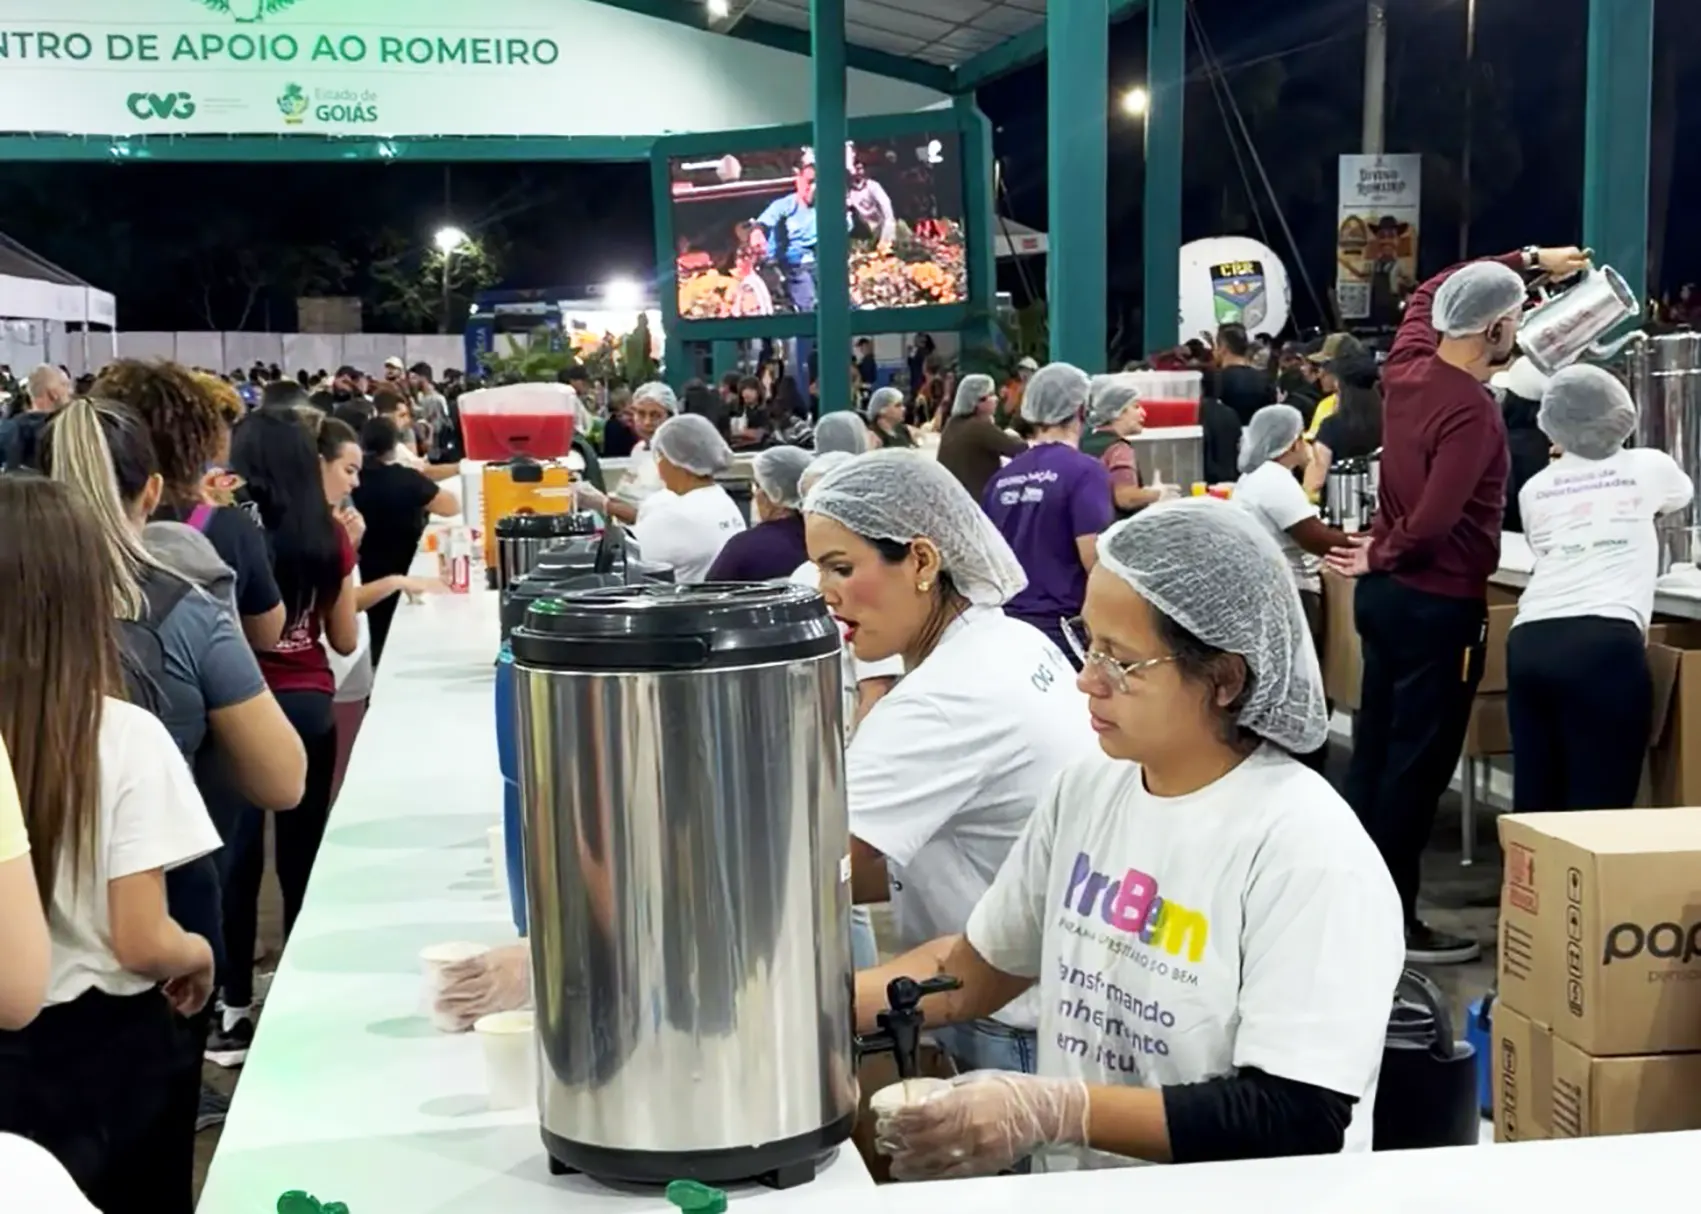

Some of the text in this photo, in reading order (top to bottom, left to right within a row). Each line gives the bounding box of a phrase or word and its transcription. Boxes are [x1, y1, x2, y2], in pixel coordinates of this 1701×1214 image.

[107, 34, 159, 61] DE
[171, 34, 299, 61] APOIO
[311, 34, 366, 62] AO
[381, 36, 559, 65] ROMEIRO
[315, 102, 378, 122] GOIÁS
